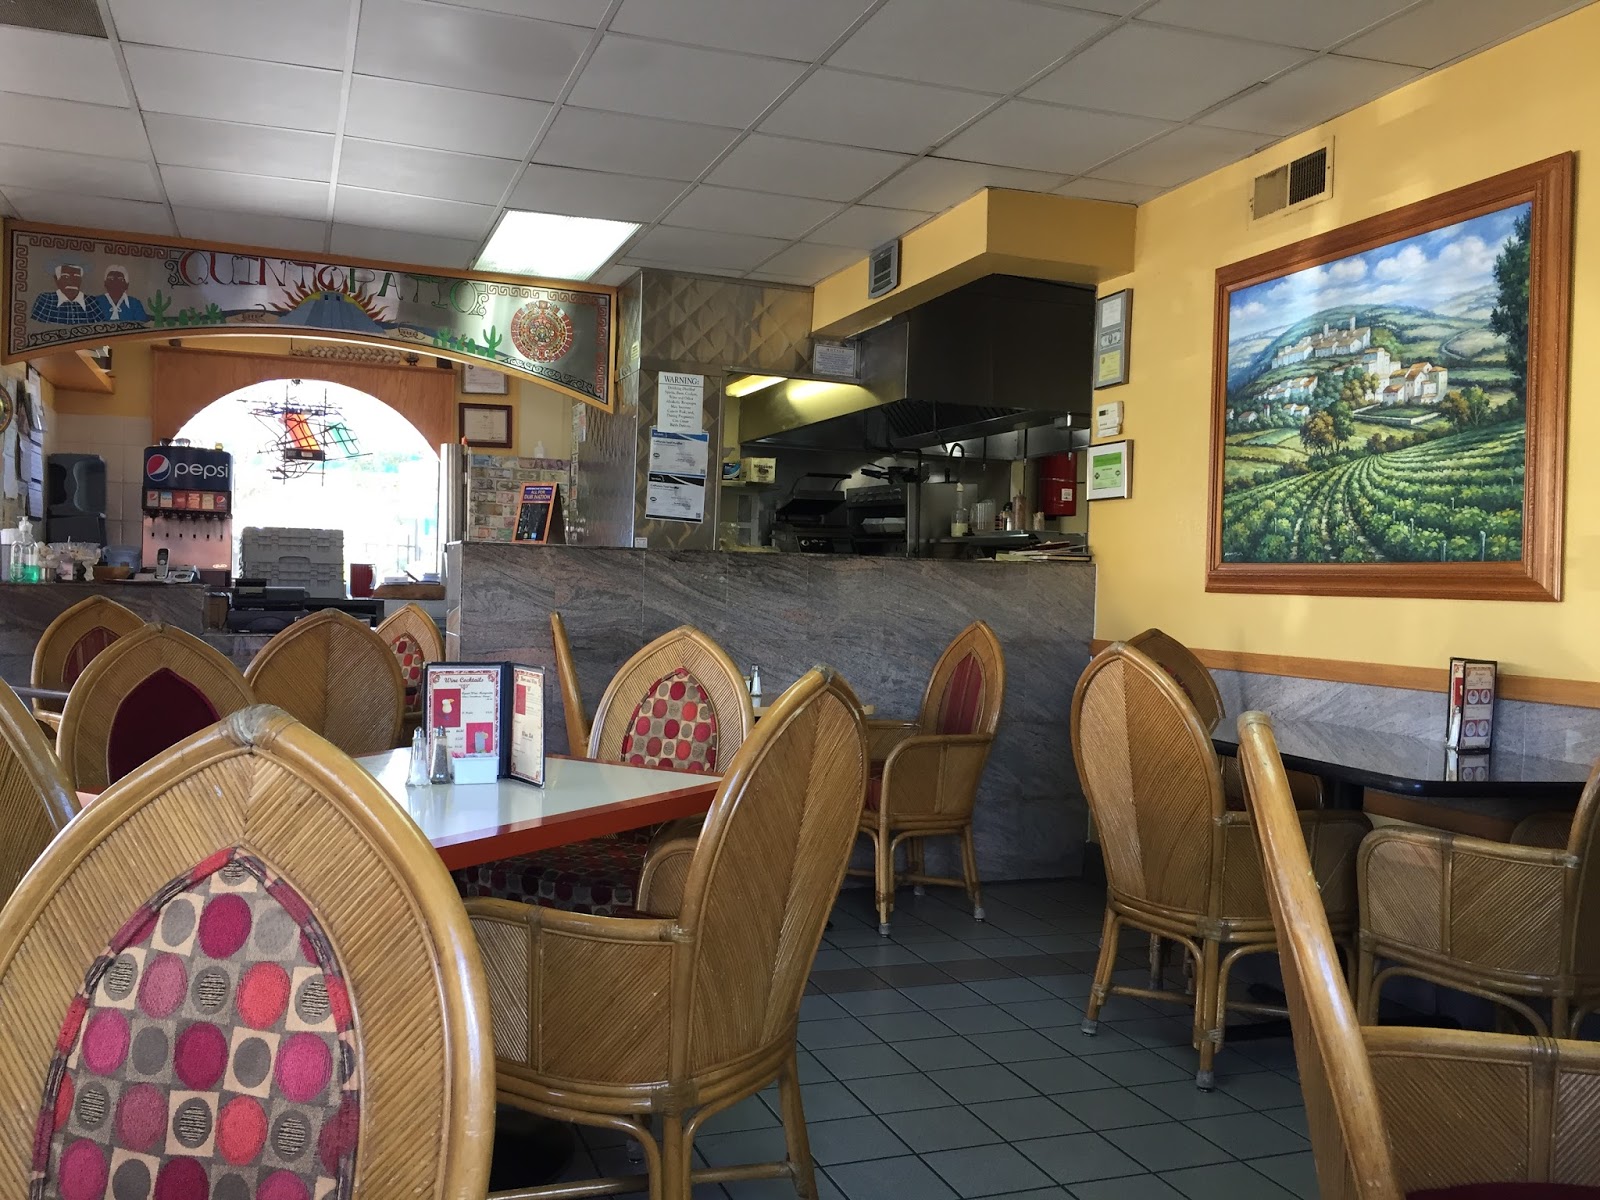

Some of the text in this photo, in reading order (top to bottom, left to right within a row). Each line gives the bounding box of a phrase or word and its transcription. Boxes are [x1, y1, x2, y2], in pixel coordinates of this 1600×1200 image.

[180, 250, 479, 315] QUINTO PATIO
[664, 375, 700, 385] WARNING:
[174, 463, 229, 480] pepsi
